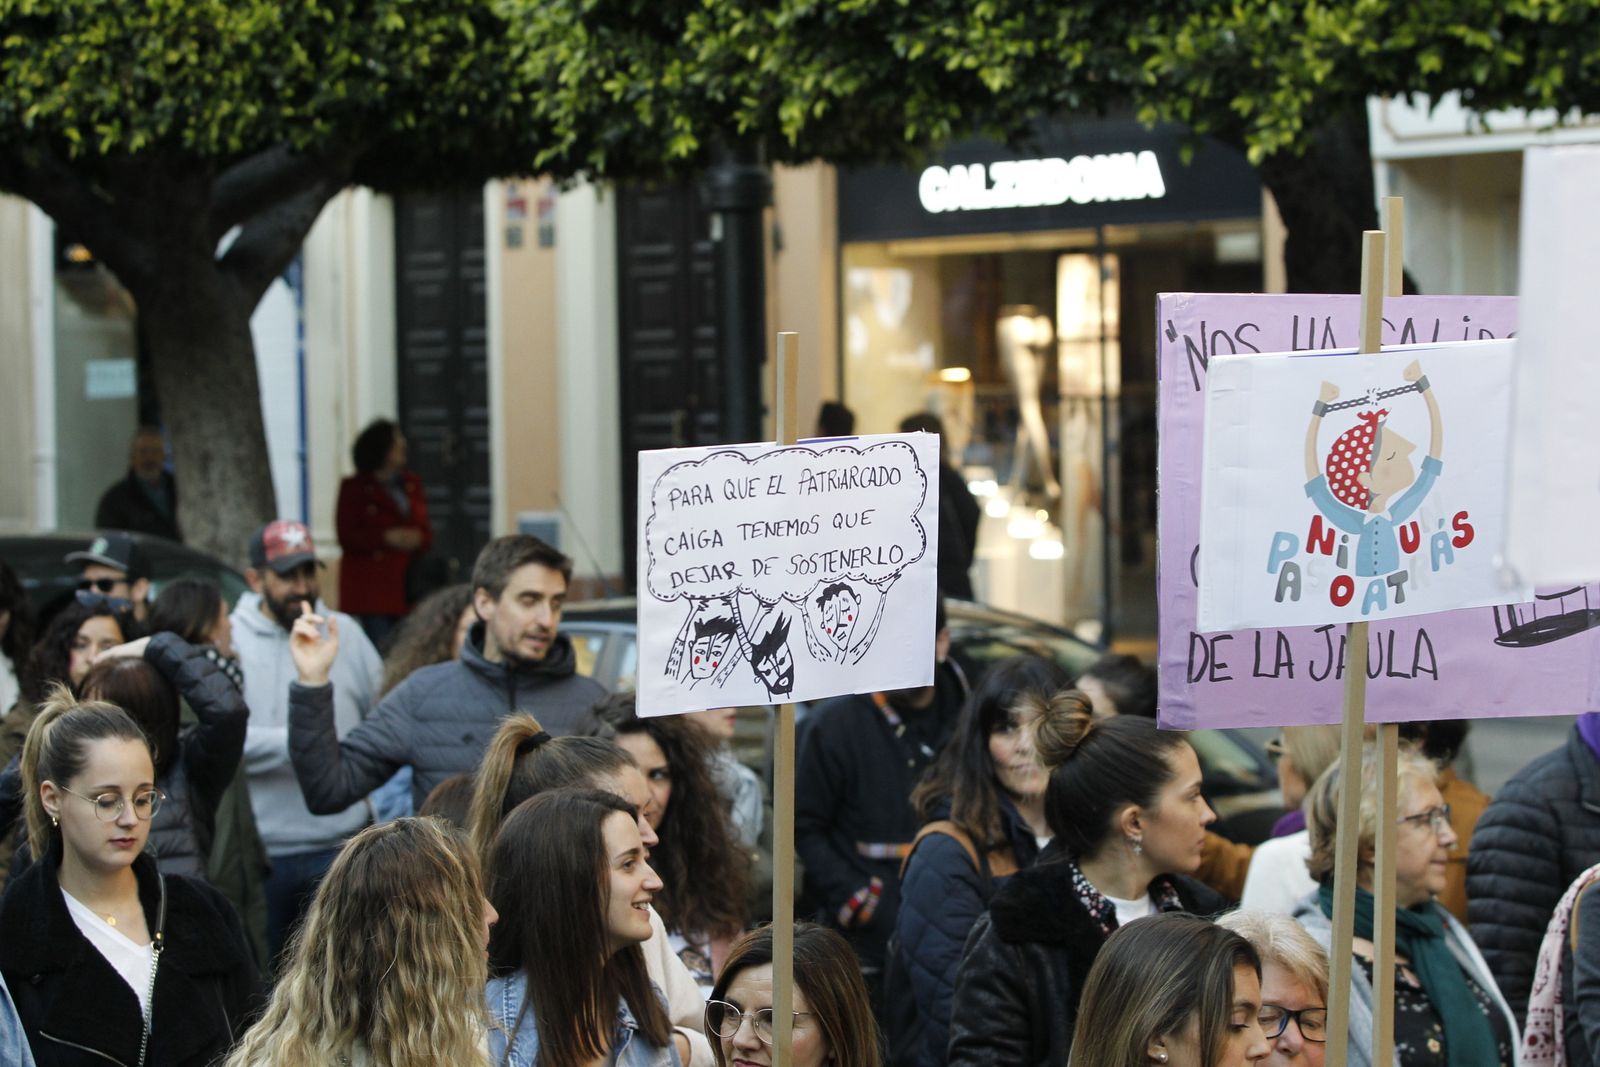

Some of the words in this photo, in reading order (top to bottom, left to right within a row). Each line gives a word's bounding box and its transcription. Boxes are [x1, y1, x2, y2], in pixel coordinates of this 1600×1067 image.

[668, 484, 713, 510] PARA
[723, 477, 760, 501] QUE
[767, 474, 785, 496] EL
[737, 514, 820, 541] TENEMOS
[832, 509, 875, 530] QUE
[671, 560, 742, 588] DEJAR
[752, 556, 779, 577] DE
[785, 544, 903, 576] SOSTENERLO
[1187, 631, 1233, 684] DE
[1252, 630, 1294, 679] LA
